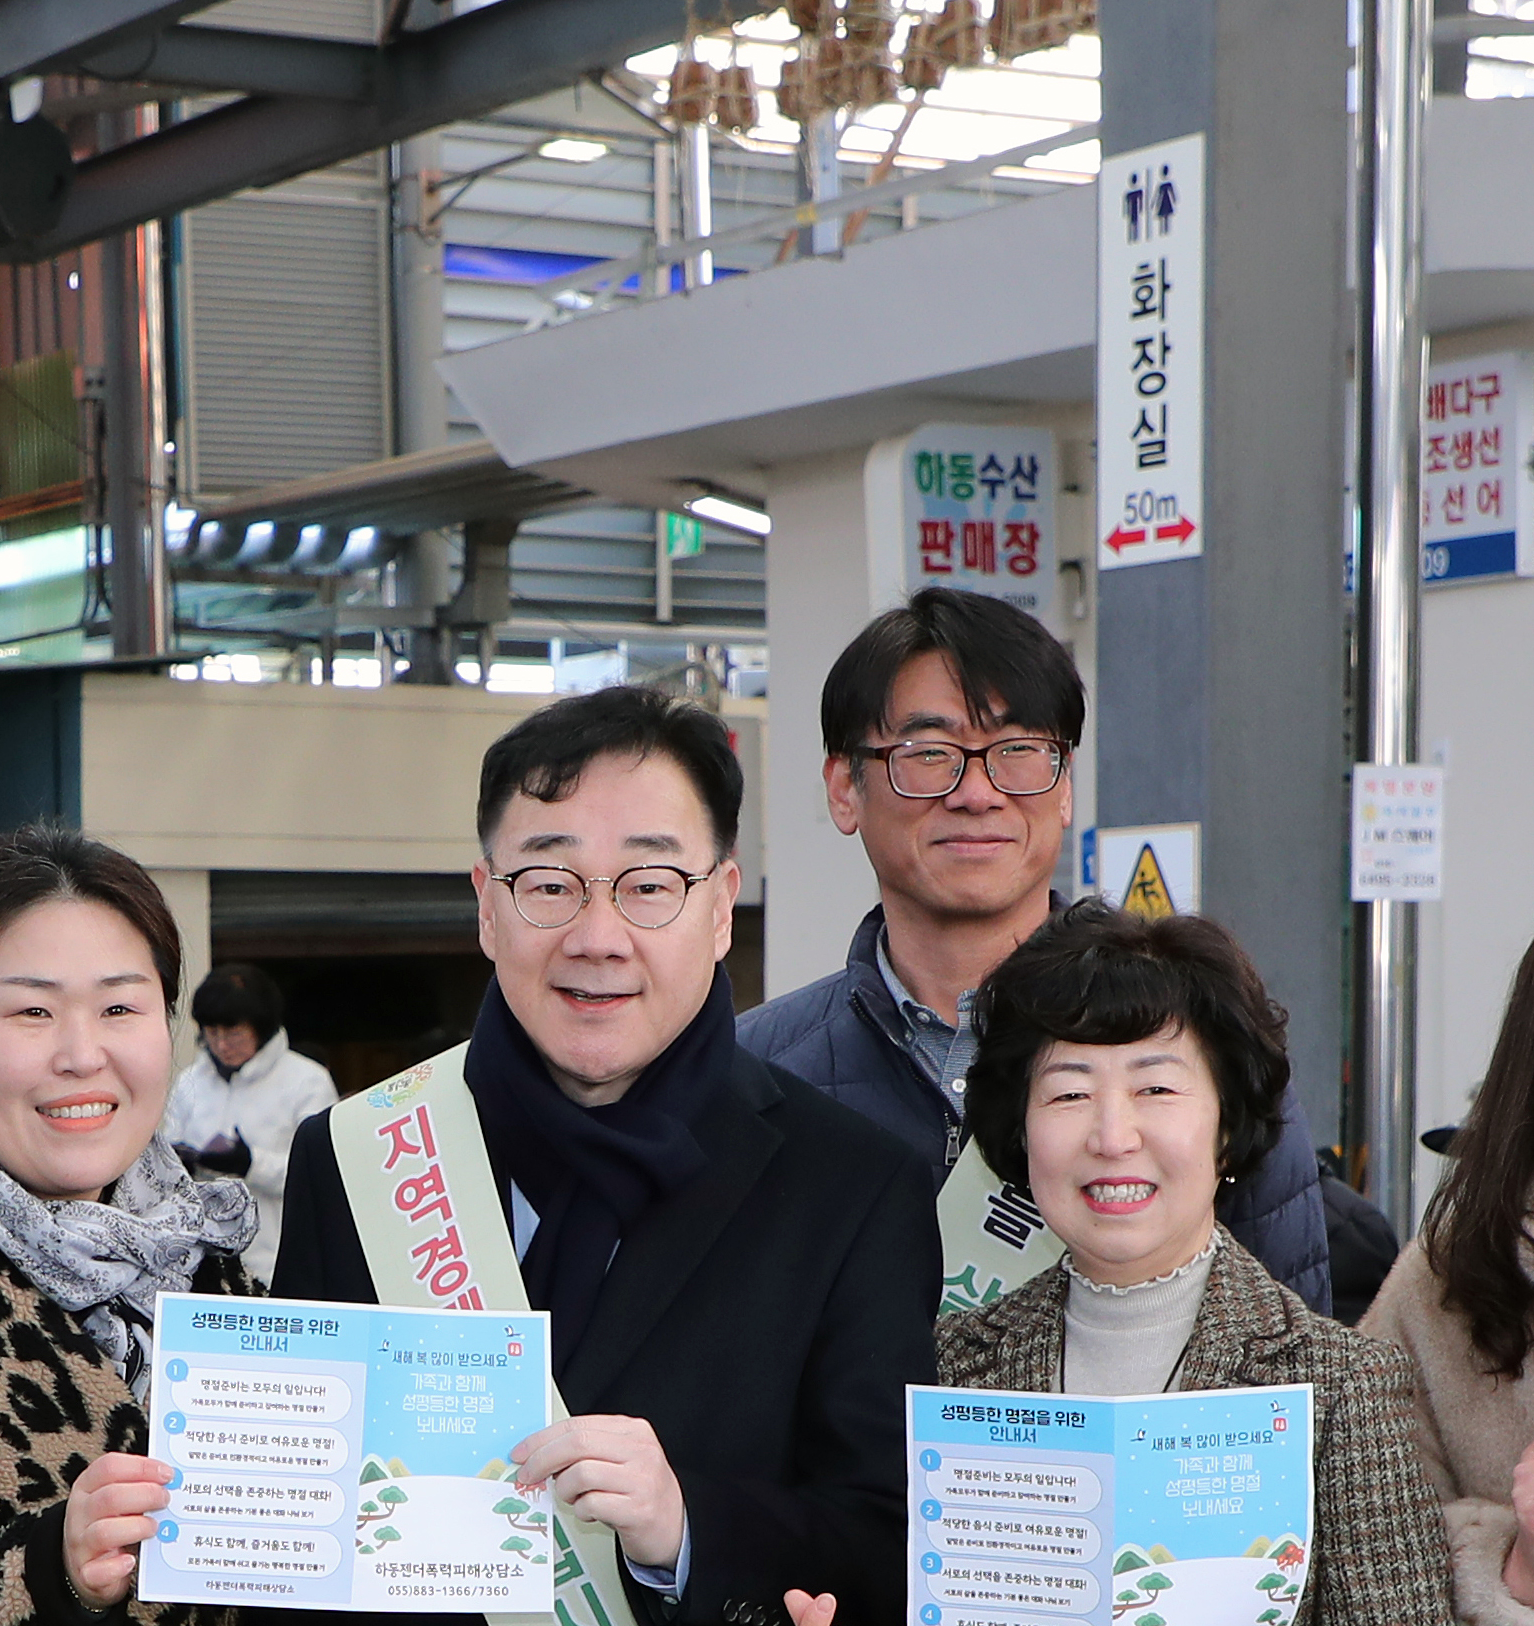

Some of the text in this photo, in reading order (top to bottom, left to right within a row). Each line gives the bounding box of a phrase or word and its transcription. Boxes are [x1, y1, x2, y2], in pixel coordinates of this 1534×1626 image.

[1130, 257, 1171, 470] 화장실
[916, 451, 1039, 502] 하동수산
[1124, 490, 1178, 526] 50m
[919, 519, 1040, 577] 판매장
[191, 1312, 340, 1336] 성평등한 명절을 위한
[241, 1335, 289, 1352] 안내서
[392, 1350, 508, 1367] 새해 복 많이 받으세요
[252, 1383, 281, 1394] 모두의
[284, 1384, 326, 1396] 일입니다!
[410, 1373, 486, 1392] 가족과 함께
[403, 1394, 494, 1413] 성평등한 명절
[169, 1418, 177, 1428] 2
[941, 1404, 1086, 1428] 성평등한 명절을 위한
[417, 1416, 477, 1434] 보내세요
[186, 1431, 215, 1442] 적당한
[217, 1433, 236, 1444] 음식
[239, 1434, 268, 1445] 준비로
[271, 1436, 310, 1448] 여유로운
[990, 1426, 1037, 1443] 안내서
[1152, 1430, 1273, 1451] 새해 복 많이 받으세요
[1174, 1454, 1253, 1475] 가족과 함께
[1004, 1472, 1032, 1484] 모두의
[1035, 1474, 1076, 1487] 일입니다!
[1165, 1474, 1261, 1497] 성평등한 명절
[182, 1484, 211, 1494] 서로의
[215, 1485, 243, 1496] 선택을
[246, 1486, 284, 1499] 존중하는
[288, 1489, 306, 1500] 명절
[926, 1506, 933, 1515] 2
[1183, 1497, 1243, 1517] 보내세요
[161, 1527, 169, 1536] 4
[942, 1518, 970, 1530] 적당한
[973, 1520, 992, 1531] 음식
[995, 1522, 1023, 1533] 준비로
[1025, 1524, 1062, 1536] 여유로운
[194, 1536, 223, 1547] 휴식도
[251, 1539, 290, 1551] 즐거움도
[293, 1541, 315, 1552] 함께!
[375, 1563, 524, 1578] 하동젠더폭력피해상담소
[926, 1558, 933, 1568] 3
[973, 1570, 1001, 1582] 선택을
[1004, 1573, 1041, 1586] 존중하는
[388, 1585, 509, 1597] 055)883-1366/7360
[925, 1610, 932, 1620] 4
